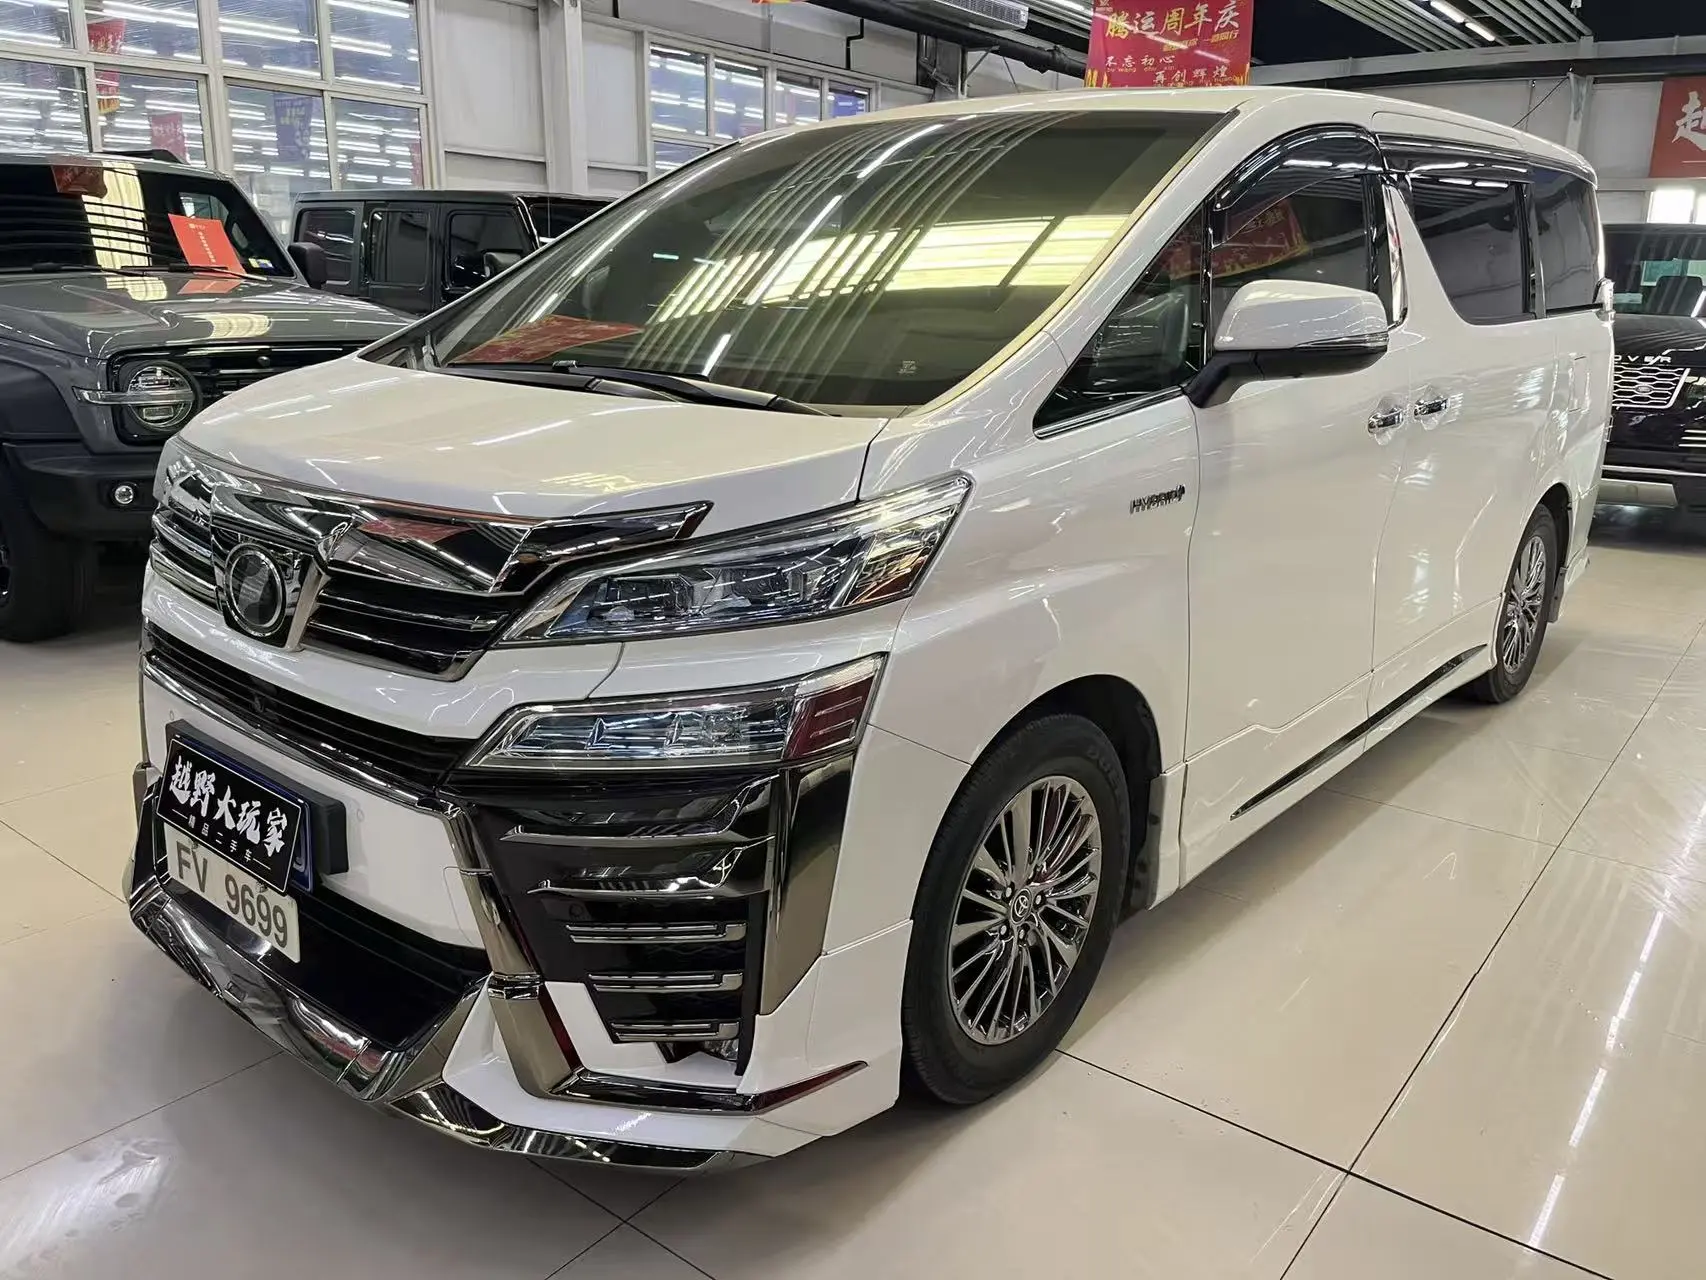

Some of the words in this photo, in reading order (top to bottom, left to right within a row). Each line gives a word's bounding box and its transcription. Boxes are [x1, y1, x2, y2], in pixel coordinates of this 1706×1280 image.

[1105, 1, 1240, 39] 腾运周年庆
[1105, 54, 1176, 69] 不忘初心
[1129, 489, 1179, 515] HYBRID
[169, 754, 288, 857] 越野大玩家
[176, 840, 208, 894] FV
[225, 874, 288, 949] 9699
